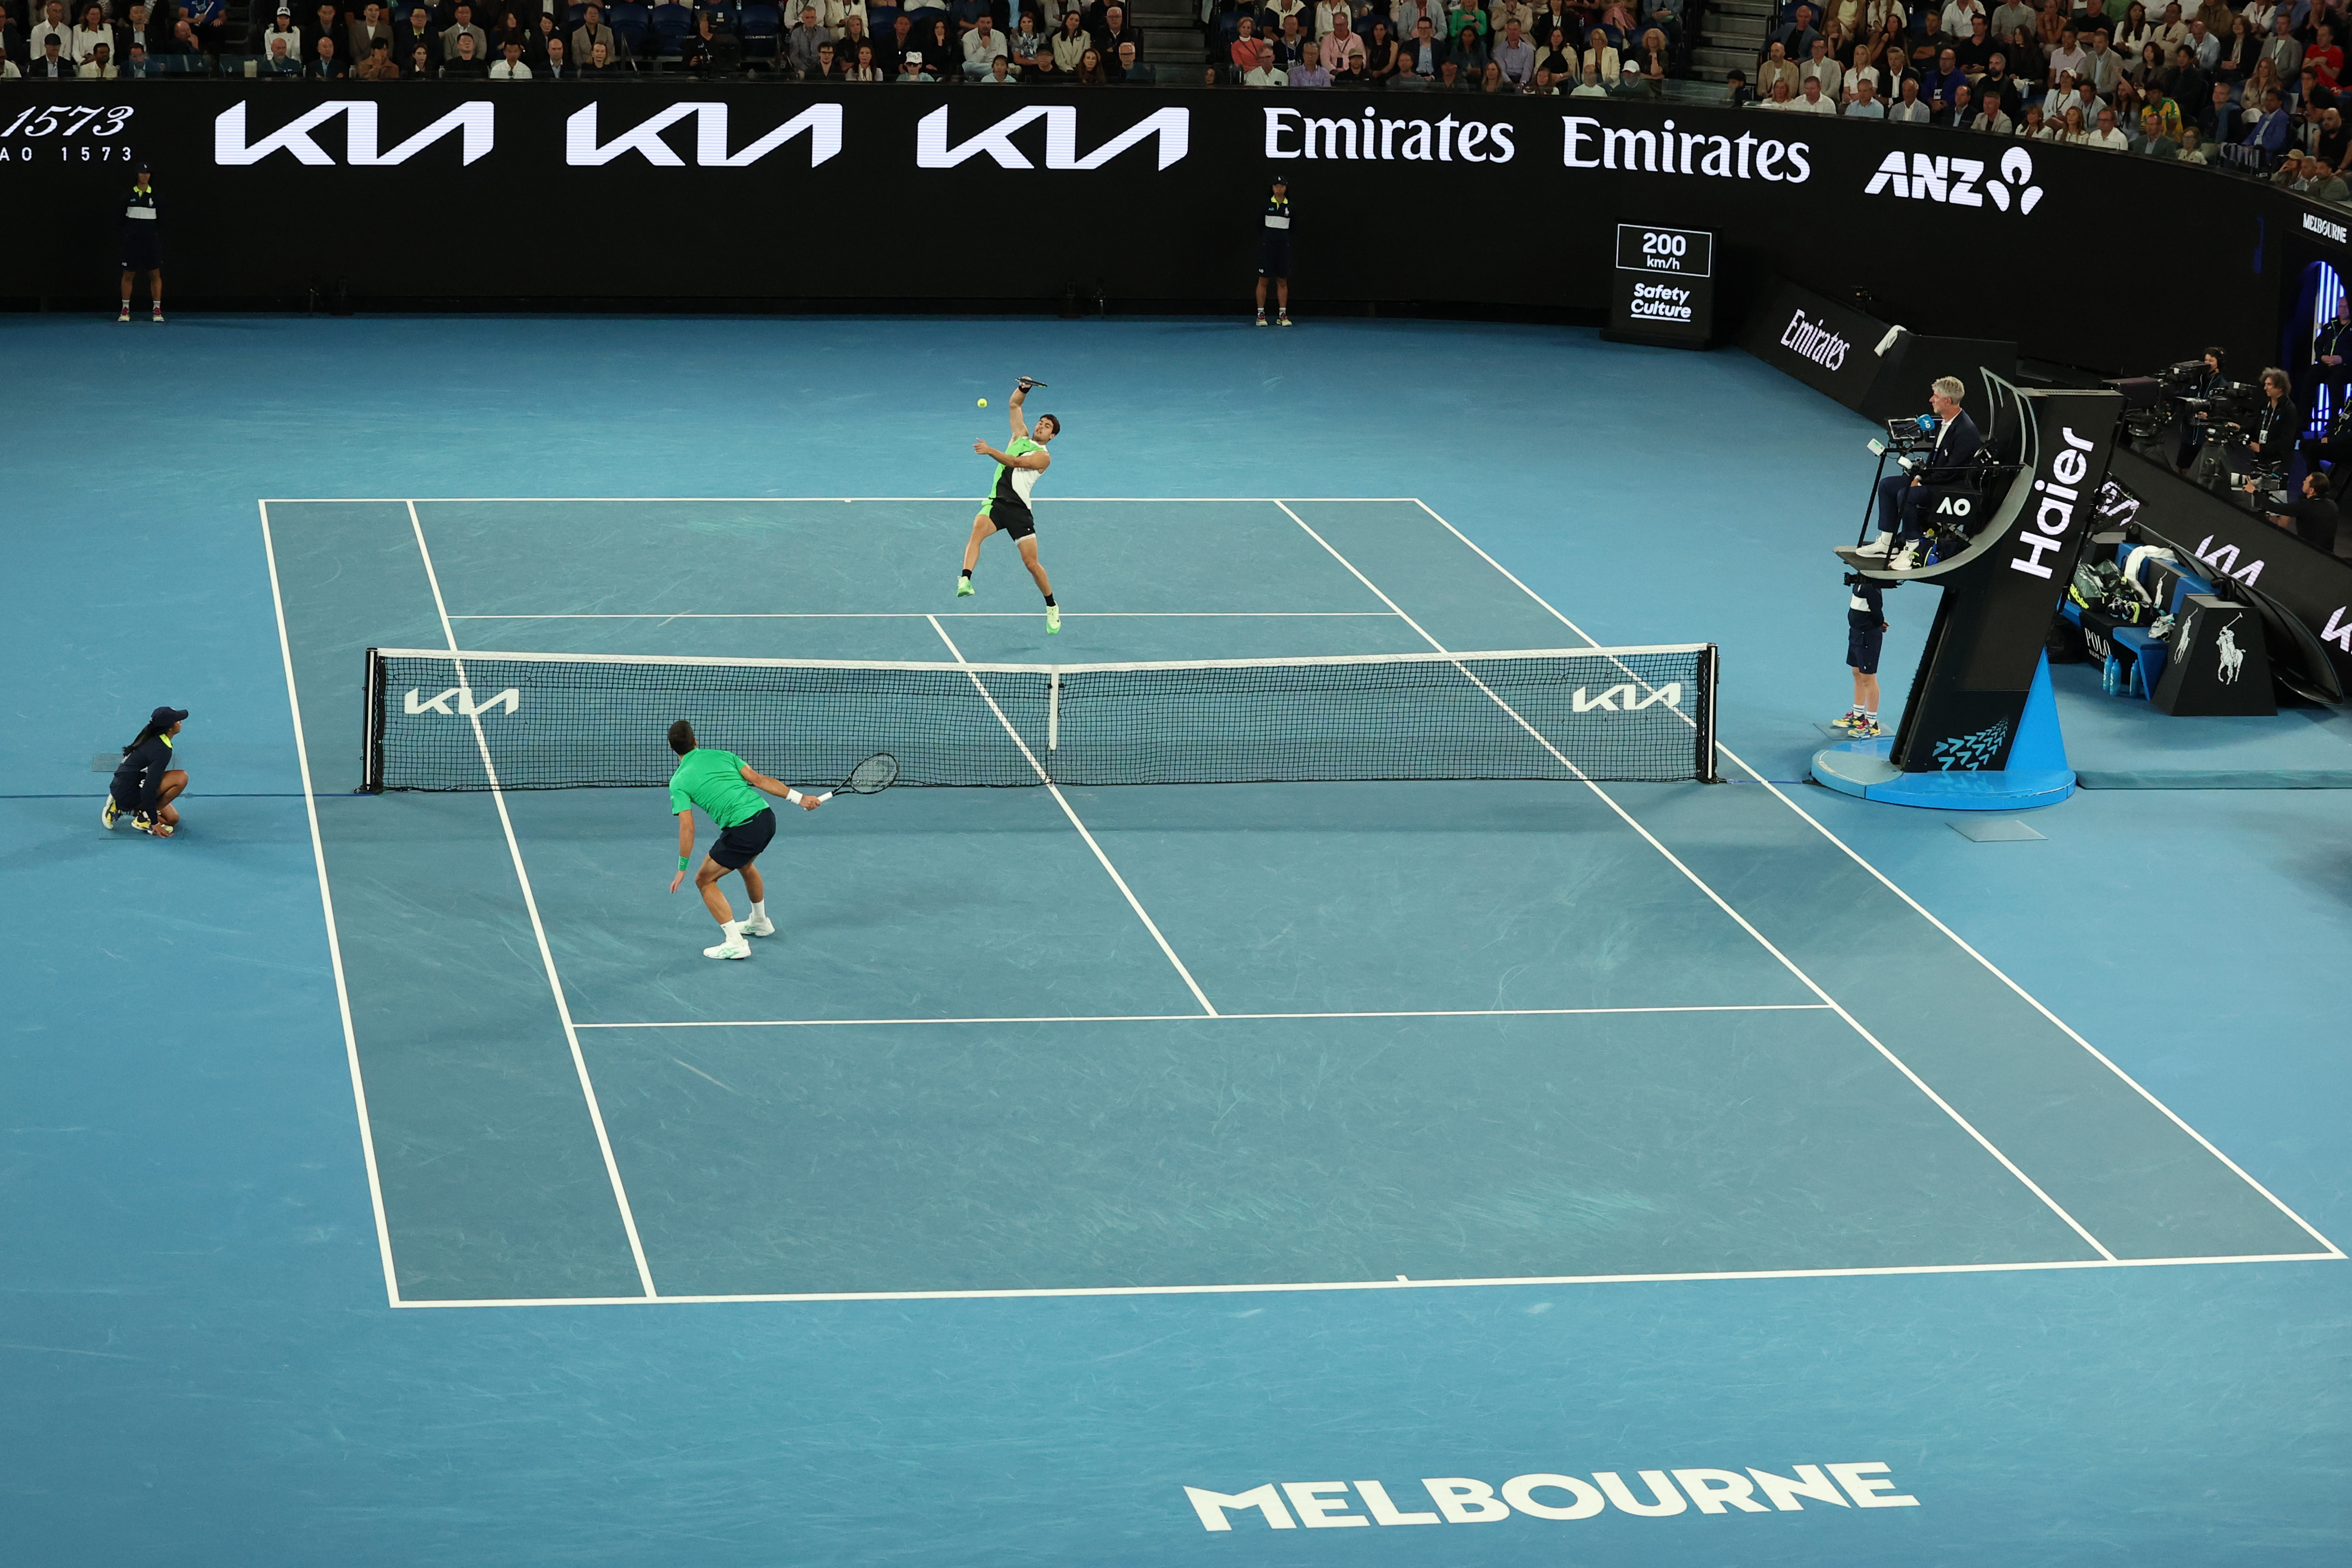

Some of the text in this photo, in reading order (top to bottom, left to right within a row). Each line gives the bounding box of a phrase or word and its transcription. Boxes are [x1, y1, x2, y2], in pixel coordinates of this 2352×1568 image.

[0, 105, 134, 137] 1573
[215, 100, 494, 167] KIA
[566, 100, 843, 168] KIA
[1263, 106, 1515, 163] Emirates
[916, 103, 1190, 171] KIA
[1562, 116, 1811, 183] Emirates
[61, 146, 131, 161] 1573
[1864, 151, 1985, 208] ANZ
[2303, 212, 2348, 243] MELBOURNE
[1643, 232, 1686, 257] 200
[1647, 255, 1680, 271] km/h
[1631, 299, 1692, 319] Culture
[1634, 283, 1691, 305] Safety
[1780, 308, 1851, 372] Emirates
[1936, 497, 1971, 516] AO
[2010, 426, 2094, 579] Haier
[2084, 627, 2111, 658] POLO
[404, 687, 520, 716] KIA
[1572, 682, 1682, 713] KIA
[1183, 1461, 1921, 1532] MELBOURNE
